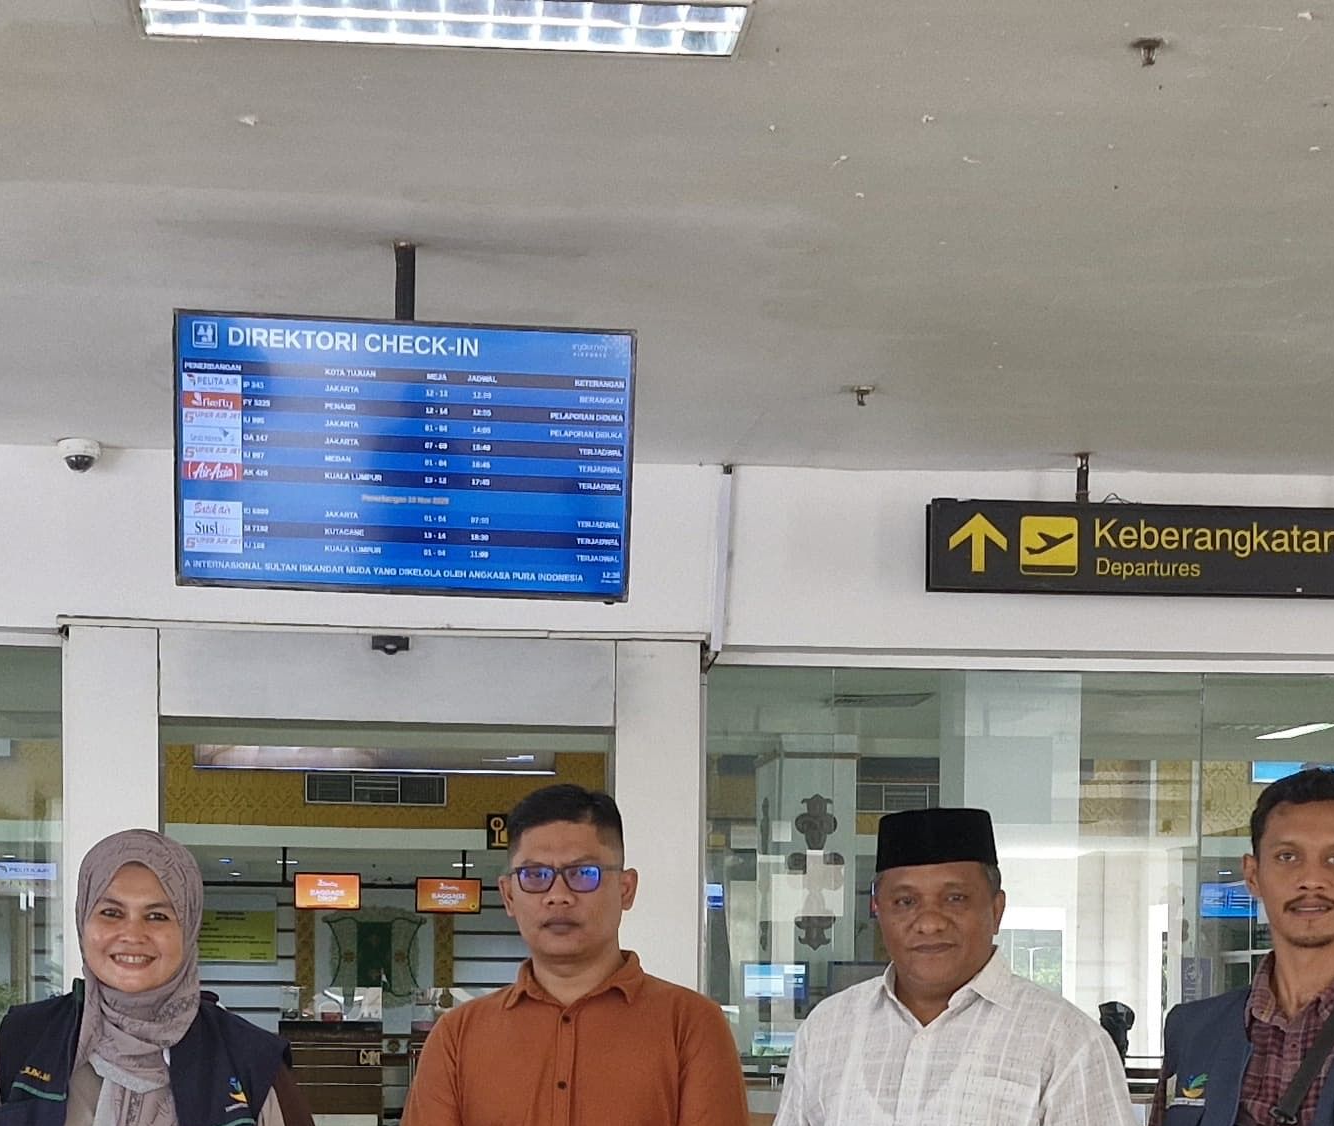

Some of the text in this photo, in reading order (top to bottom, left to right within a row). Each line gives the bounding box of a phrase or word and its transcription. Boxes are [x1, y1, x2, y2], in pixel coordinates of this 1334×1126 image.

[228, 326, 479, 357] DIREKTORI CHECK-IN
[184, 361, 242, 372] PENERBANGAN
[325, 368, 345, 377] KOTA
[468, 374, 498, 383] JADWAL
[574, 378, 625, 389] KETERANGAN
[325, 384, 359, 394] JAKARTA
[579, 396, 624, 405] BERANGKAT
[325, 420, 359, 428] JAKARTA
[550, 429, 594, 438] PELAPORAN
[325, 437, 359, 446] JAKARTA
[325, 472, 382, 483] KUALA LUMPUR
[325, 511, 358, 519] JAKARTA
[325, 545, 382, 555] KUALA LUMPUR
[192, 560, 262, 571] INTERNASIONAL
[265, 562, 297, 572] SULTAN
[299, 564, 344, 575] ISKANDAR
[346, 566, 371, 575] MUDA
[373, 567, 396, 576] YANG
[398, 568, 442, 578] DIKELOLA
[443, 569, 466, 579] OLEH
[468, 570, 510, 580] ANGKASA
[512, 572, 536, 581] PURA
[537, 573, 583, 582] INDONESIA
[1096, 557, 1201, 578] Departures
